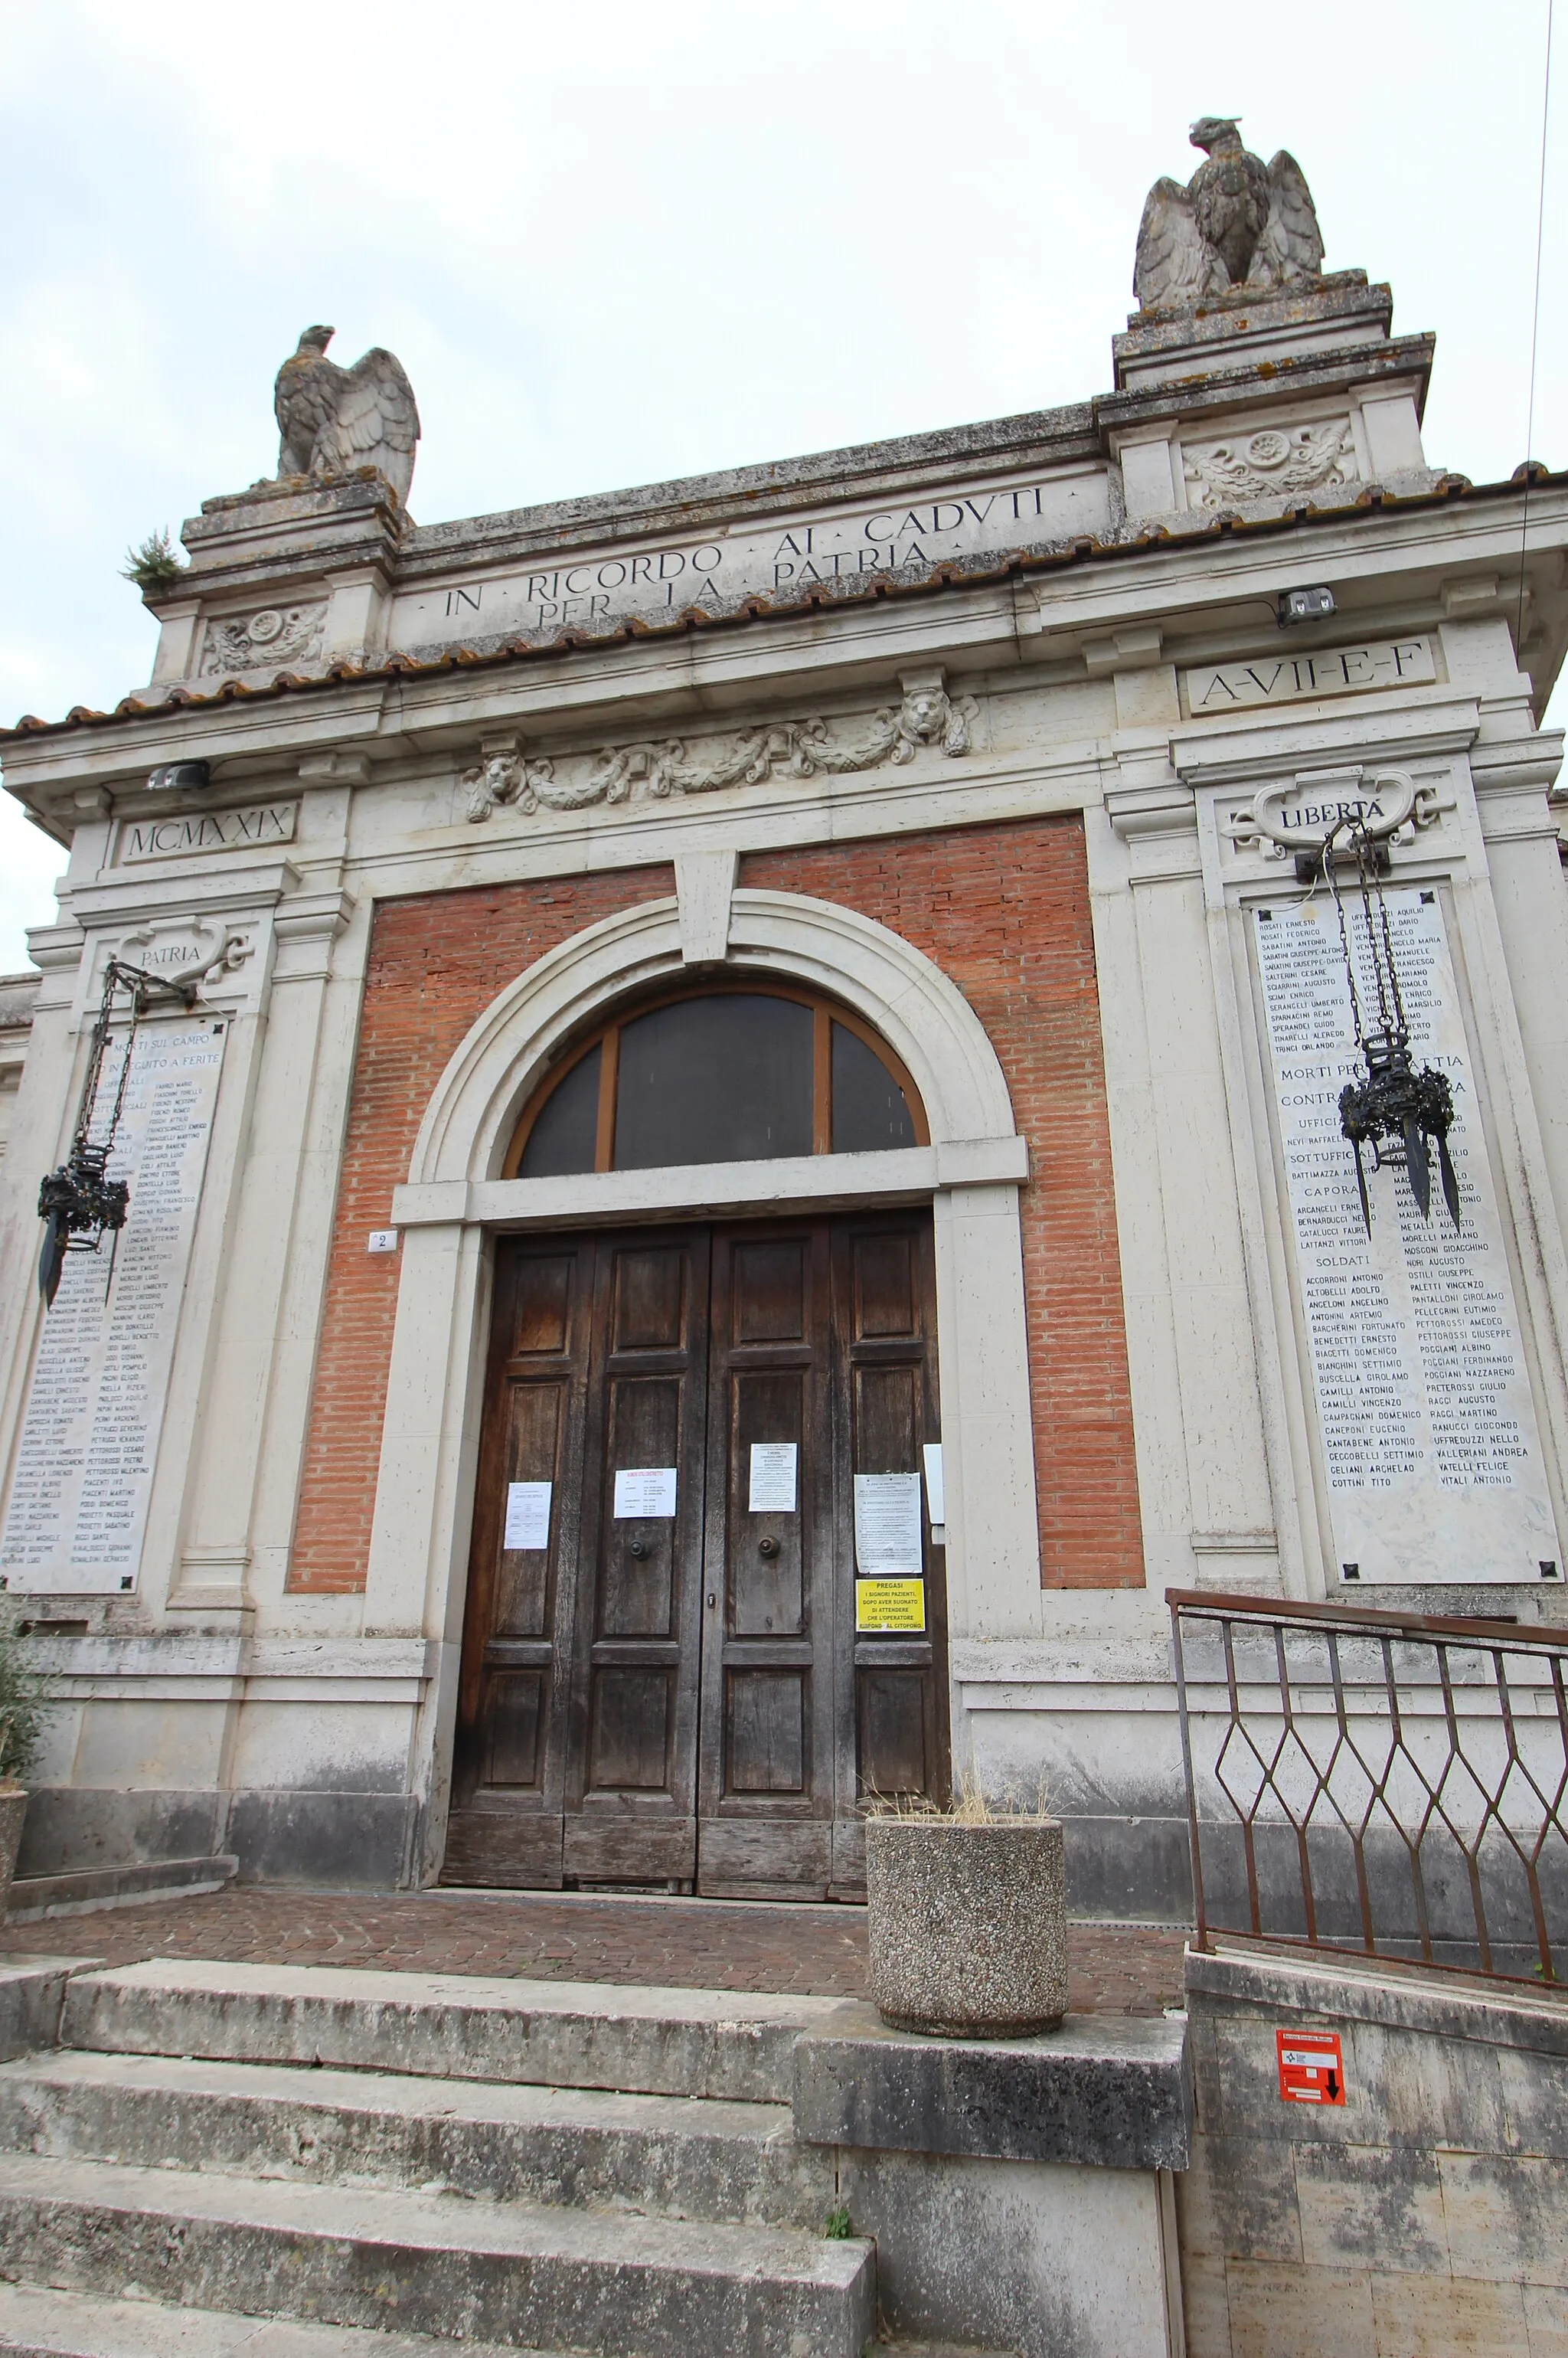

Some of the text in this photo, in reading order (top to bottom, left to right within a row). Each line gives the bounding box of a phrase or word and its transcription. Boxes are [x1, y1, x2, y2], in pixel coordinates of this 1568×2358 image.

[446, 488, 1043, 616] IN RICORDO AI CADVTI
[773, 541, 928, 588] PATRIA
[128, 806, 289, 855] MCMXXIX
[1259, 919, 1315, 931] ROSATI ERNESTO
[1398, 917, 1419, 926] DARIO
[1259, 928, 1320, 941] ROSATI FEDERICO
[1417, 936, 1441, 944] MARIA
[1261, 938, 1327, 951] SABATINI ANTONIO
[142, 947, 201, 966] PATRIA
[1263, 952, 1289, 961] SABATINI
[1263, 962, 1291, 971] SABATINI
[1265, 968, 1327, 981] SALTERINI CESARE
[1304, 978, 1335, 987] AUGUSTO
[1289, 990, 1314, 999] ENRICO
[1405, 989, 1432, 998] ENRICO
[1311, 998, 1344, 1008] UMBERTO
[1407, 999, 1442, 1009] MARSILIO
[1313, 1009, 1334, 1018] REMO
[1272, 1020, 1334, 1032] SPERANDEI GUIDO
[151, 1038, 168, 1048] SUL
[173, 1035, 209, 1046] CAMPO
[1274, 1034, 1308, 1043] TINARELLI
[1275, 1042, 1334, 1053] TRINCI ORLANDO
[183, 1055, 220, 1066] FERITE
[1280, 1066, 1331, 1081] MORTI
[1292, 1169, 1338, 1179] BATTIMAZZA
[1296, 1205, 1337, 1215] ARCANGELI
[1298, 1216, 1348, 1226] BERNARDUCCI
[1400, 1222, 1434, 1231] METALLI
[1299, 1228, 1338, 1238] CATALUCCI
[1402, 1234, 1436, 1243] MORELLI
[379, 1235, 386, 1247] 2
[1300, 1240, 1334, 1250] LATTANZI
[1403, 1246, 1439, 1255] MOSCONI
[1315, 1255, 1370, 1267] SOLDATI
[1429, 1257, 1465, 1266] AUGUSTO
[1305, 1273, 1383, 1285] ACCORRONI ANTONIO
[1408, 1268, 1474, 1280] OSTILI GIUSEPPE
[1307, 1286, 1380, 1297] ALTOBELLI ADOLFO
[1410, 1280, 1484, 1292] PALETTI VINCENZO
[1308, 1297, 1389, 1309] ANGELONI ANGELINO
[1412, 1292, 1504, 1304] PANTALLONI GIROLAMO
[1310, 1310, 1382, 1321] ANTONINI ARTEMIO
[1414, 1305, 1496, 1316] PELLEGRINI EUTIMIO
[1361, 1321, 1406, 1331] FORTUNATO
[1416, 1316, 1503, 1329] PETTOROSSI AMEDEO
[1313, 1335, 1397, 1346] BENEDETTI ERNESTO
[1418, 1329, 1512, 1341] PETTOROSSI GIUSEPPE
[1354, 1347, 1397, 1356] DOMENICO
[1419, 1343, 1491, 1354] POGGIANI ALBINO
[1317, 1359, 1402, 1370] BIANCHINI SETTIMIO
[1423, 1355, 1514, 1366] POGGIANI FERDINANDO
[1318, 1372, 1409, 1384] BUSCELLA GIROLAMO
[1424, 1368, 1515, 1379] POGGIANI NAZZARENO
[1320, 1385, 1393, 1396] CAMILLI ANTONIO
[1426, 1382, 1507, 1393] PRETEROSSI GIULIO
[1321, 1398, 1402, 1409] CAMILLI VINCENZO
[1457, 1395, 1496, 1405] AUGUSTO
[1378, 1411, 1421, 1420] DOMENICO
[1459, 1408, 1498, 1417] MARTINO
[1325, 1425, 1406, 1435] CANEPONI EUGENIO
[1432, 1421, 1518, 1431] RANUCCI GIOCONDO
[1327, 1437, 1415, 1448] CANTABENE ANTONIO
[1433, 1434, 1520, 1445] UFFREDUZZI NELLO
[1383, 1450, 1424, 1460] SETTIMIO
[1436, 1447, 1528, 1458] VALLERIANI ANDREA
[1331, 1464, 1414, 1474] CELIANI ARCHELAO
[1439, 1461, 1509, 1471] VATELLI FELICE
[1440, 1475, 1511, 1485] VITALI ANTONIO
